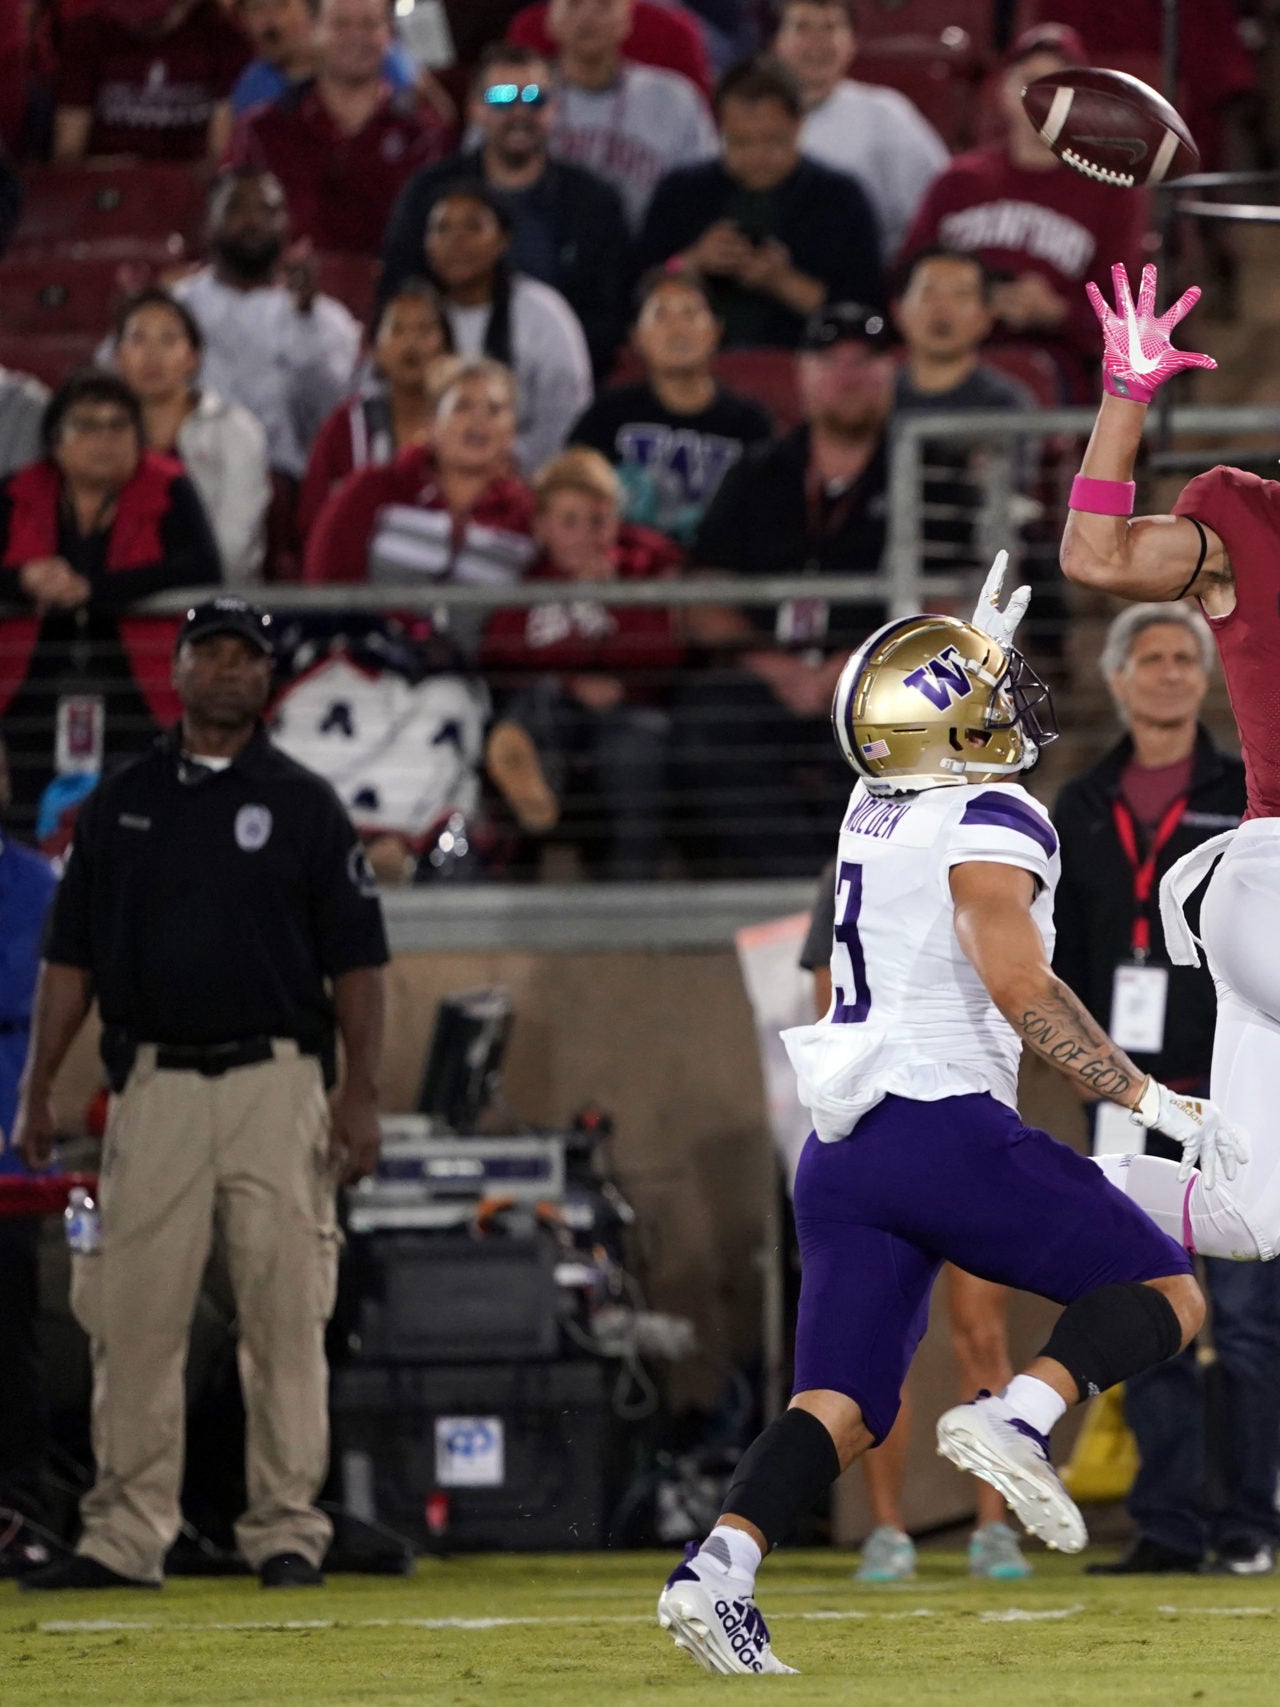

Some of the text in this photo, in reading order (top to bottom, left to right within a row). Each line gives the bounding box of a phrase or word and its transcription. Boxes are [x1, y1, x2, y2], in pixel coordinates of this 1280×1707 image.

[902, 645, 974, 712] W
[844, 793, 912, 840] MOLDEN
[831, 860, 872, 1024] 3
[1019, 1011, 1130, 1095] SON OF GOD
[1169, 1099, 1205, 1127] adidas
[714, 1599, 763, 1673] adidas
